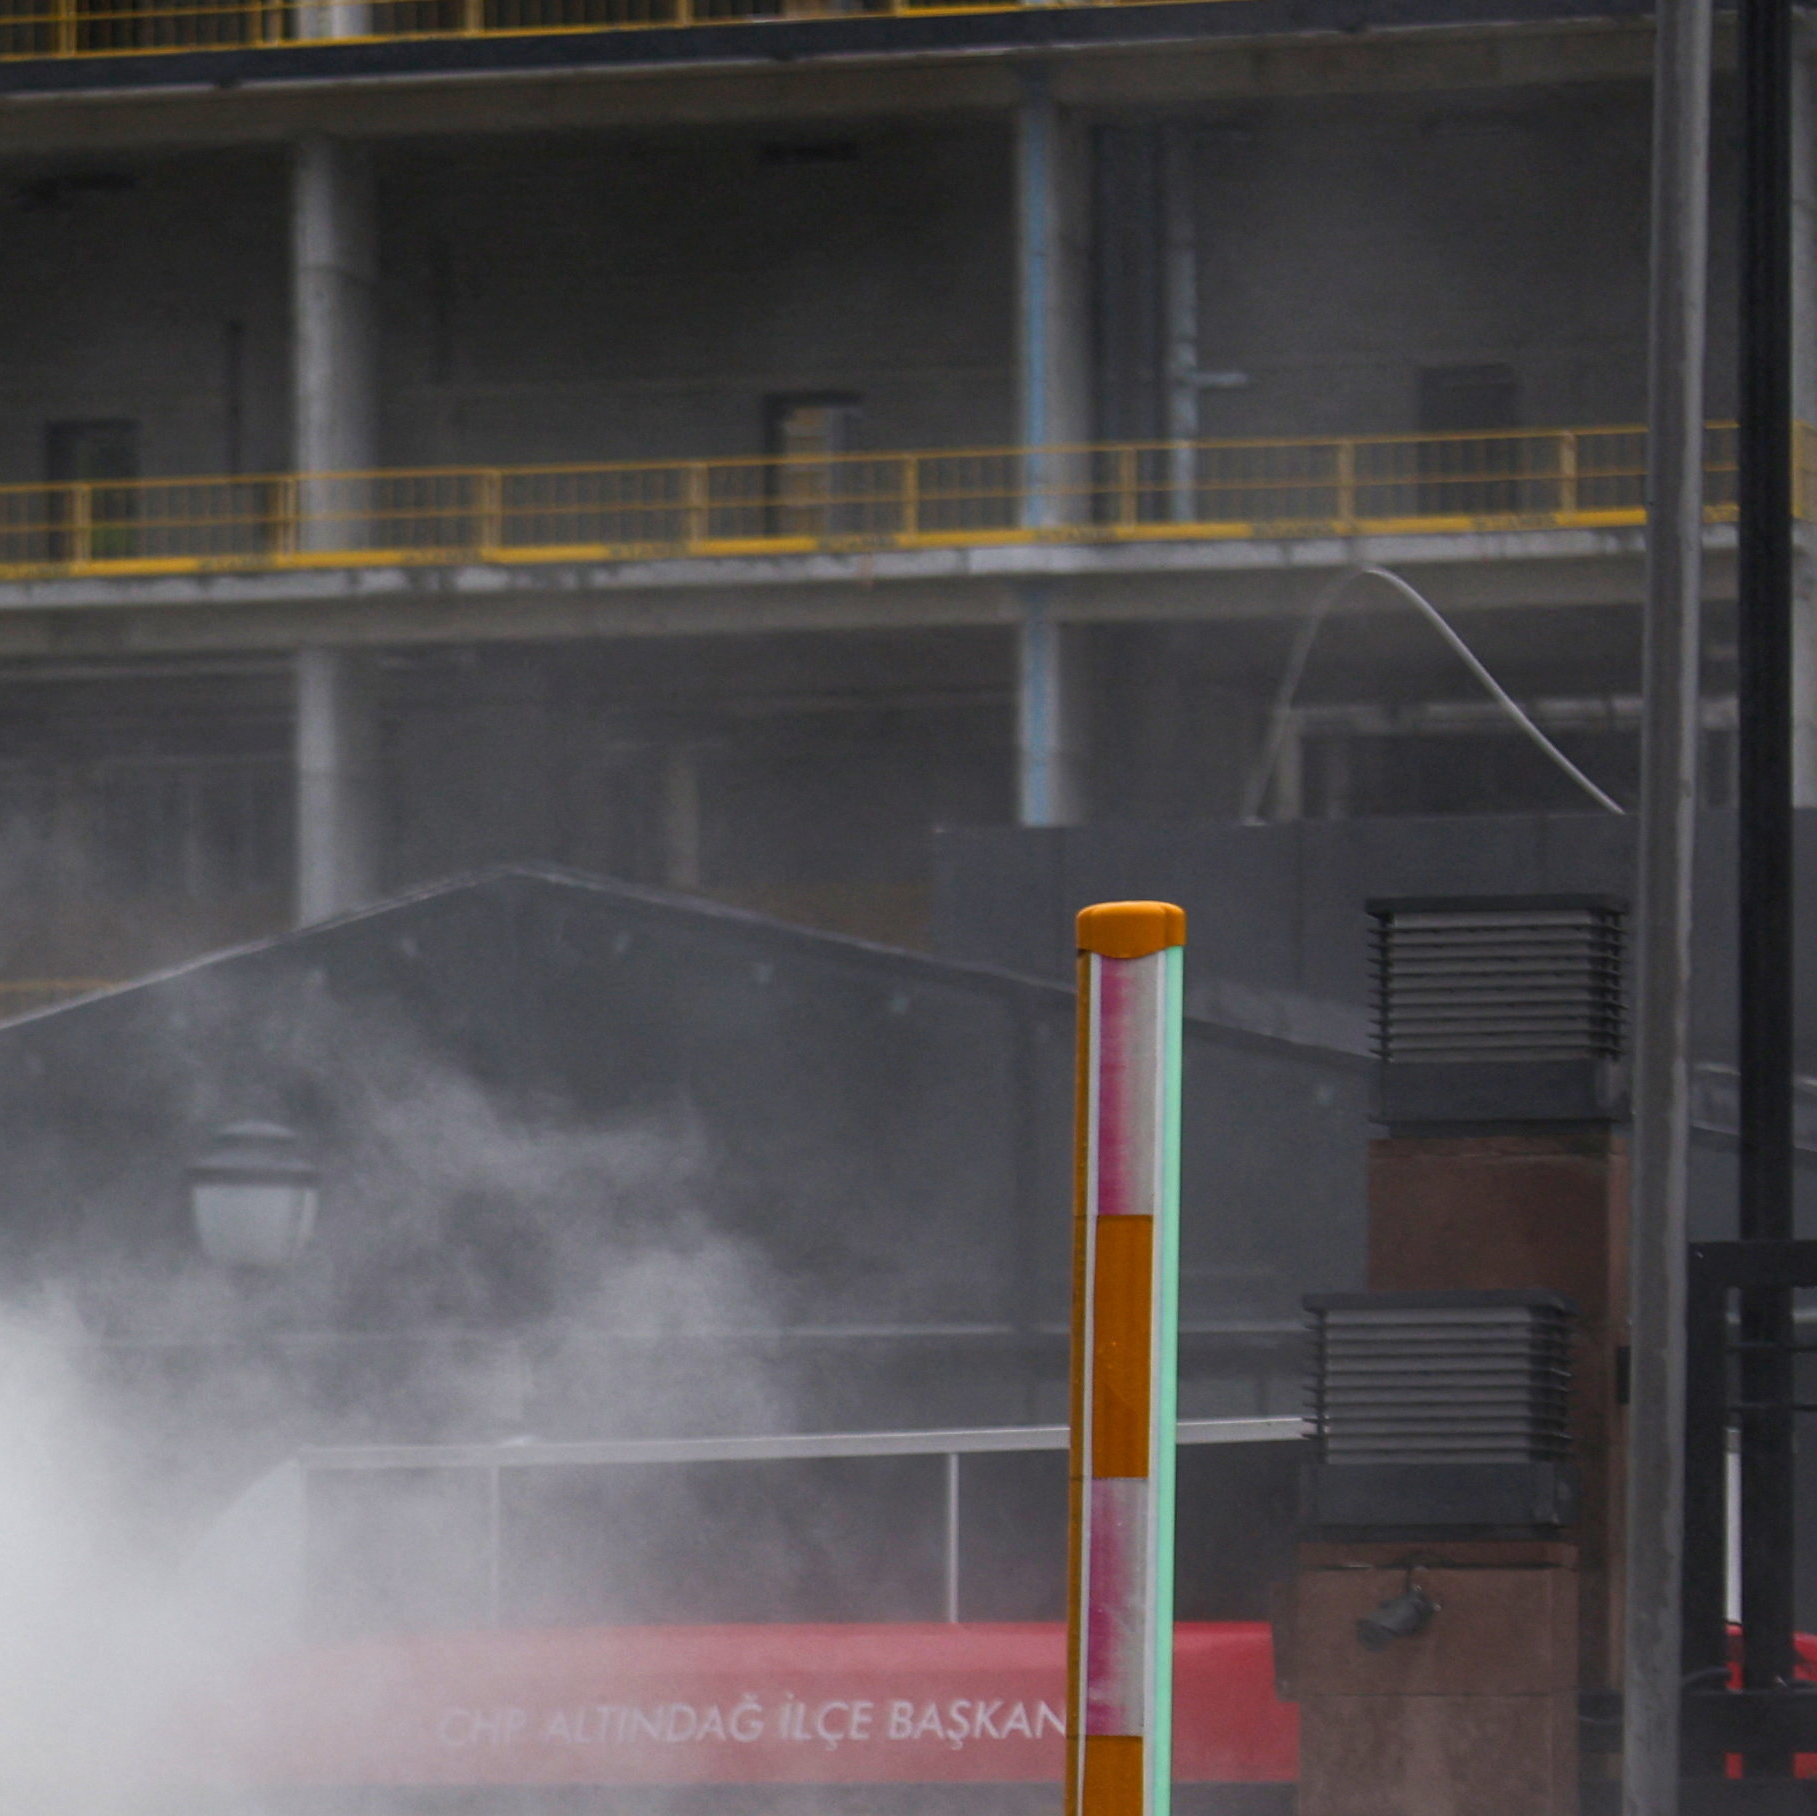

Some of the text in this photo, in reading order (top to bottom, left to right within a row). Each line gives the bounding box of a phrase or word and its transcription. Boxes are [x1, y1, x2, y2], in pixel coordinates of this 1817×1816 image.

[439, 1705, 526, 1748] CHP
[541, 1692, 765, 1746] ALTINDAĞ
[777, 1692, 874, 1750] İLÇE
